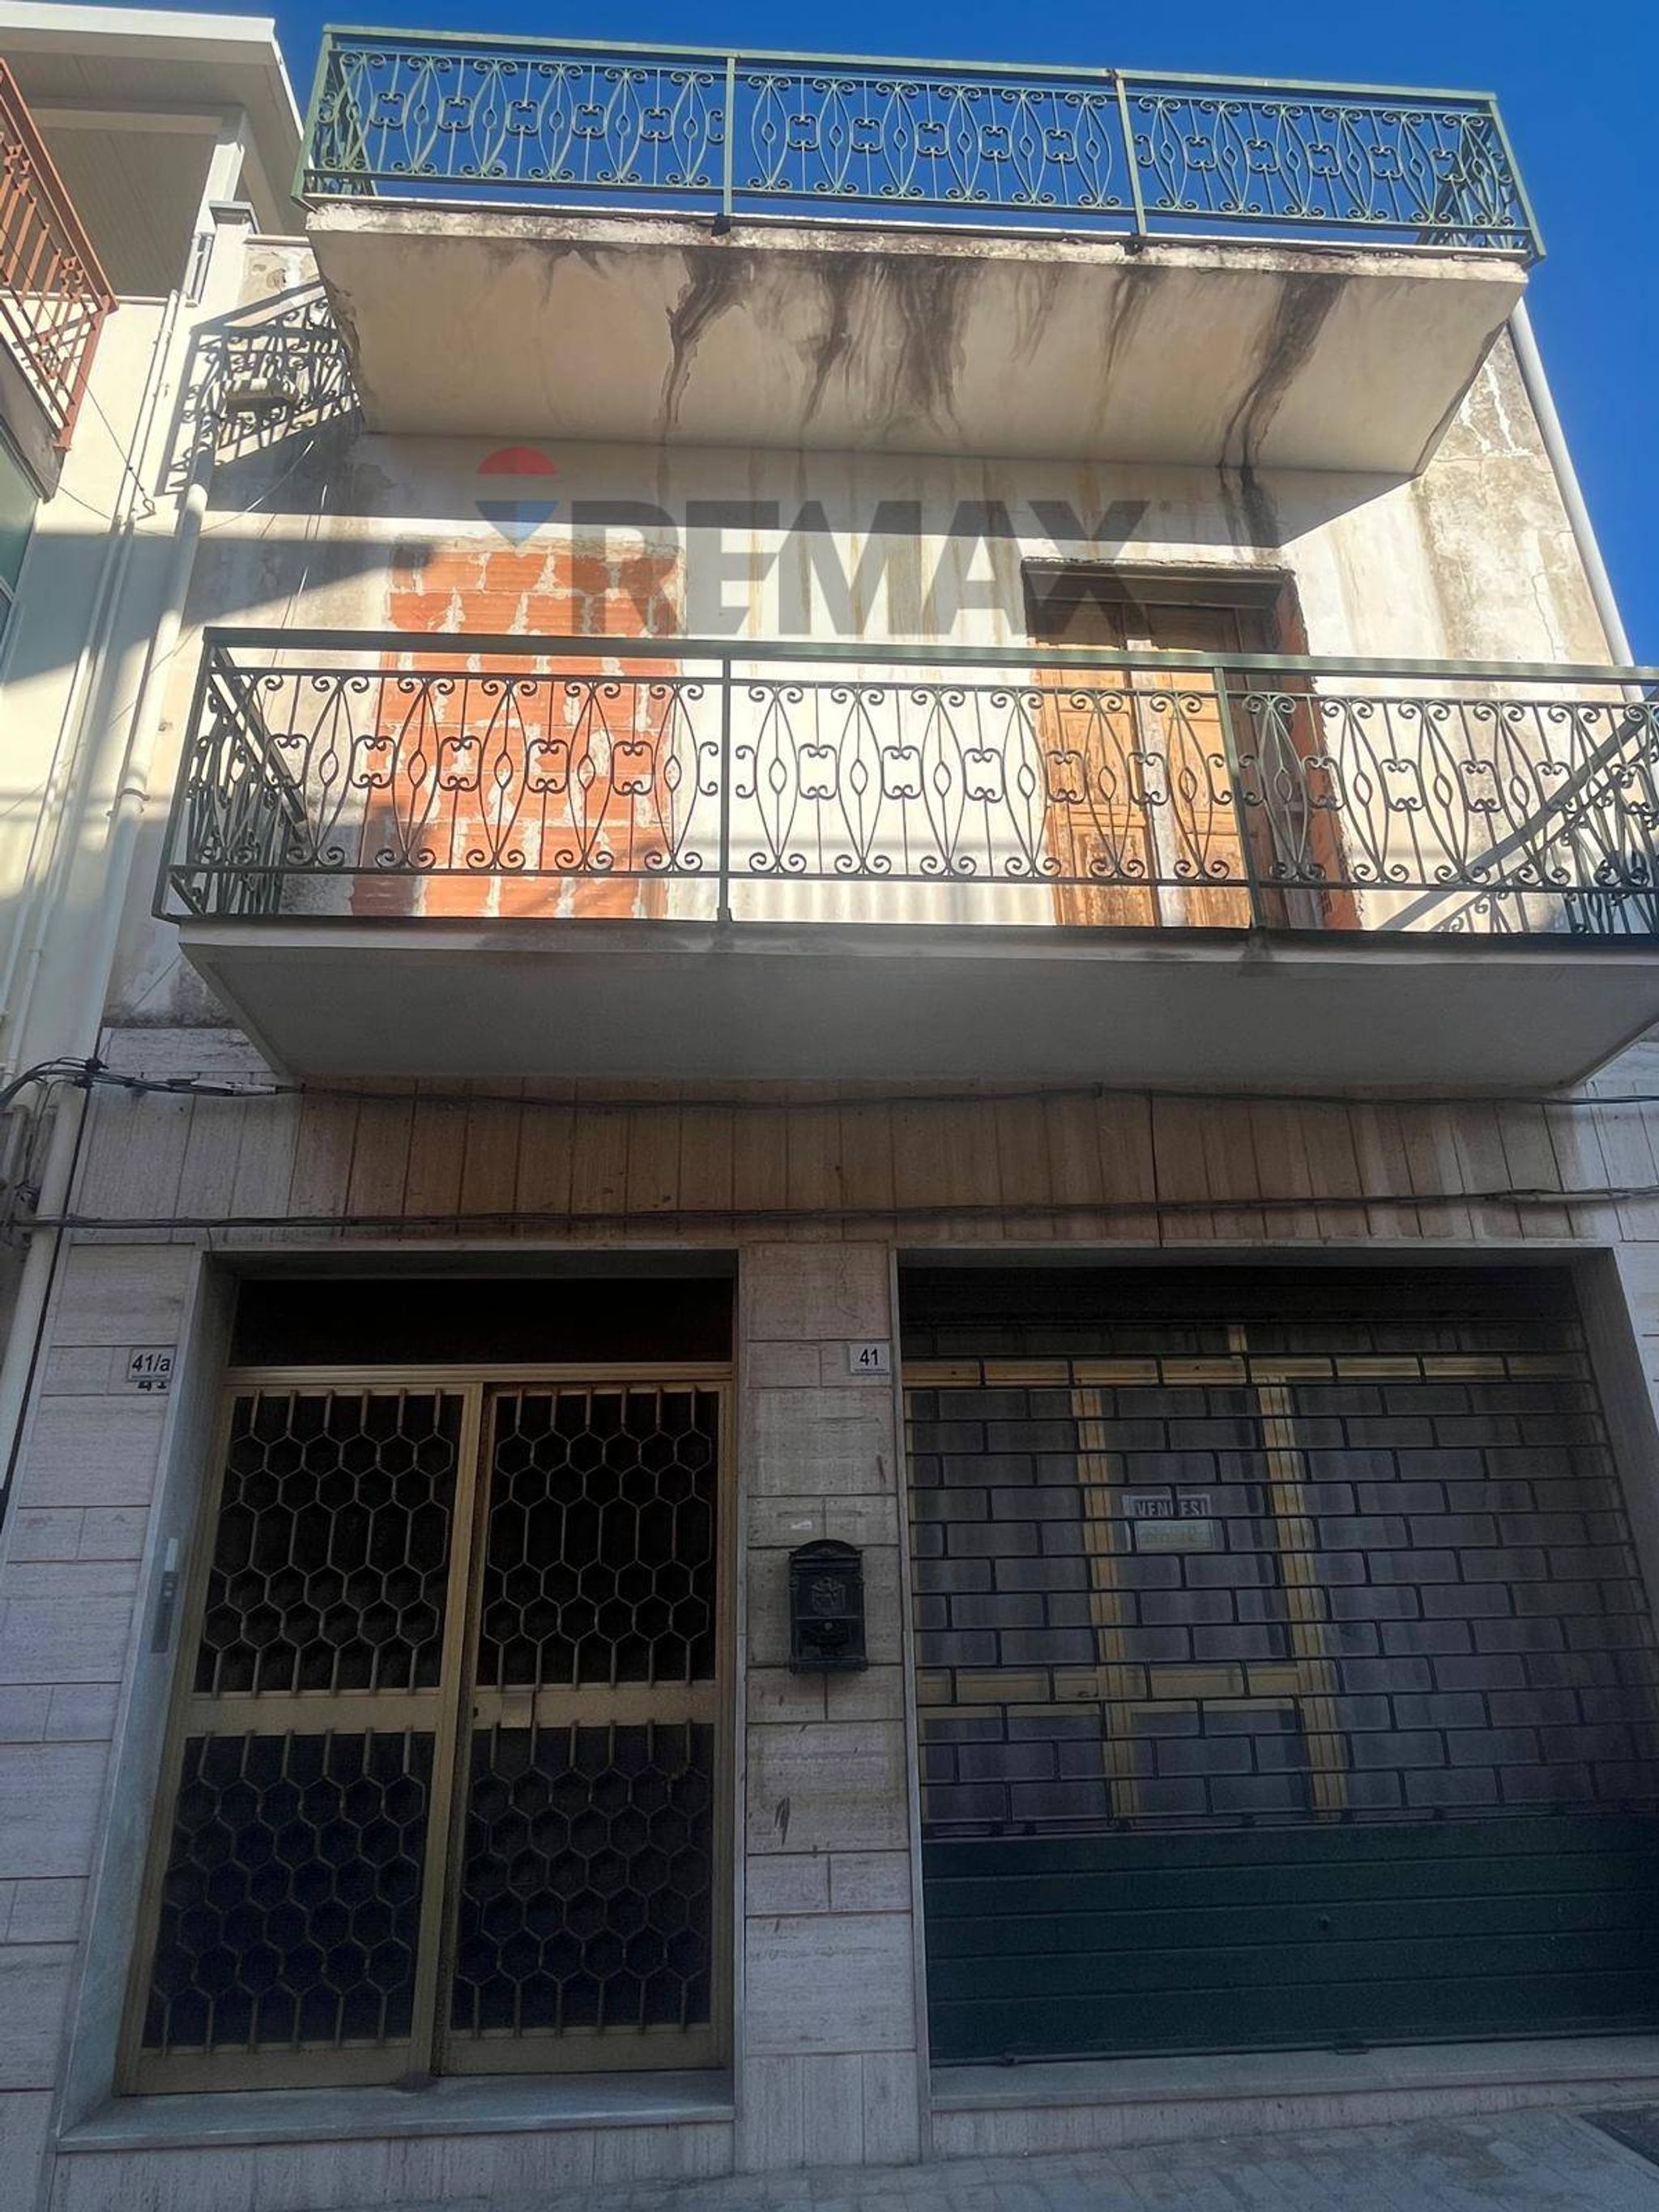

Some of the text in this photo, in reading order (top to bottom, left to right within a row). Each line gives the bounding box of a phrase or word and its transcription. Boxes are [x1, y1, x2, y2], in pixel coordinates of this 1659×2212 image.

[132, 1353, 171, 1372] 41/a
[859, 1349, 878, 1366] 41
[1137, 1501, 1205, 1516] VENESI
